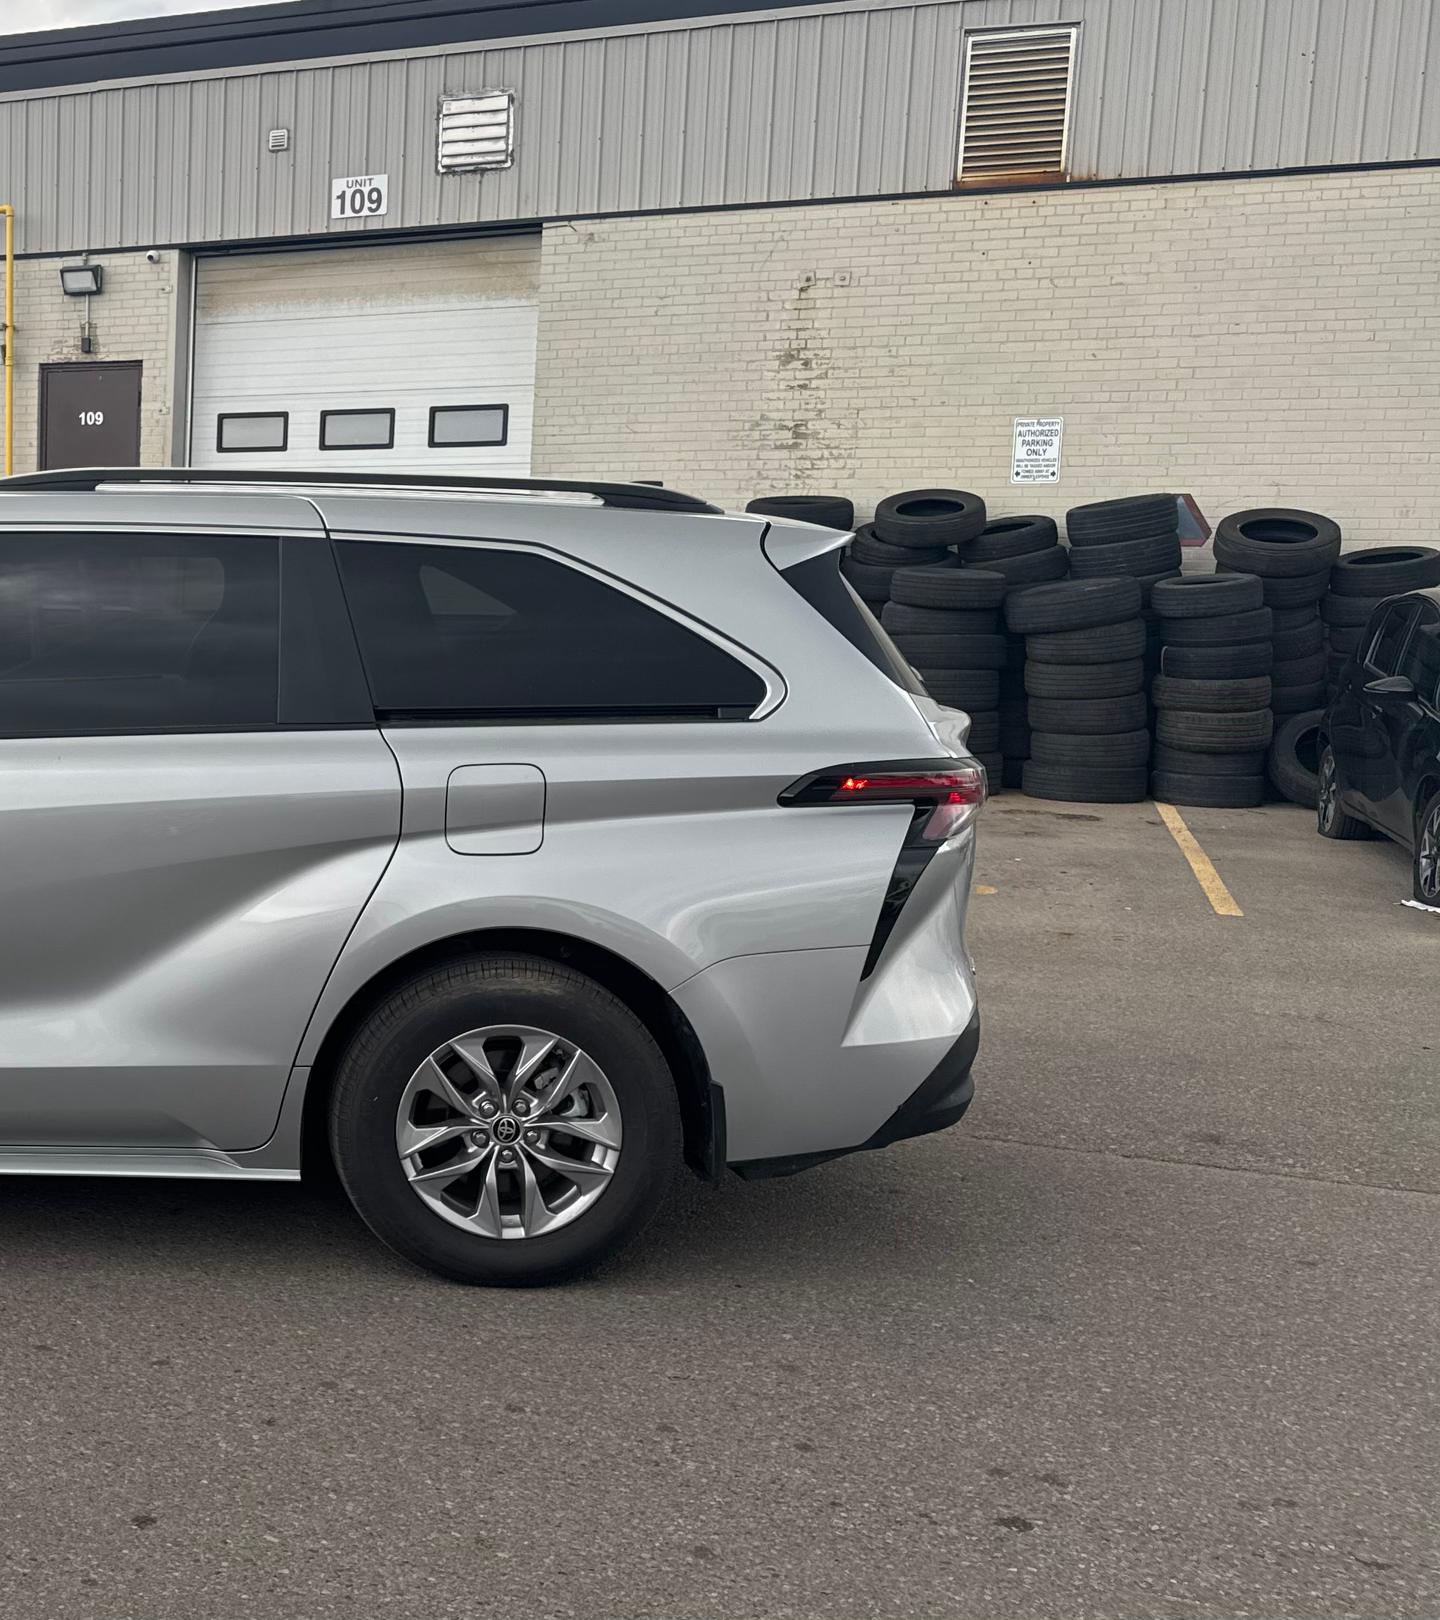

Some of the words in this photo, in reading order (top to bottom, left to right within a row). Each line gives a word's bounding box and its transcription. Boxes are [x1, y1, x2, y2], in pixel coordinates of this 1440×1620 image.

[346, 178, 374, 189] UNIT
[336, 187, 382, 215] 109
[79, 411, 104, 426] 109
[1018, 429, 1059, 438] AUTHORIZED
[1022, 439, 1054, 448] PARKING
[1026, 448, 1048, 457] ONLY
